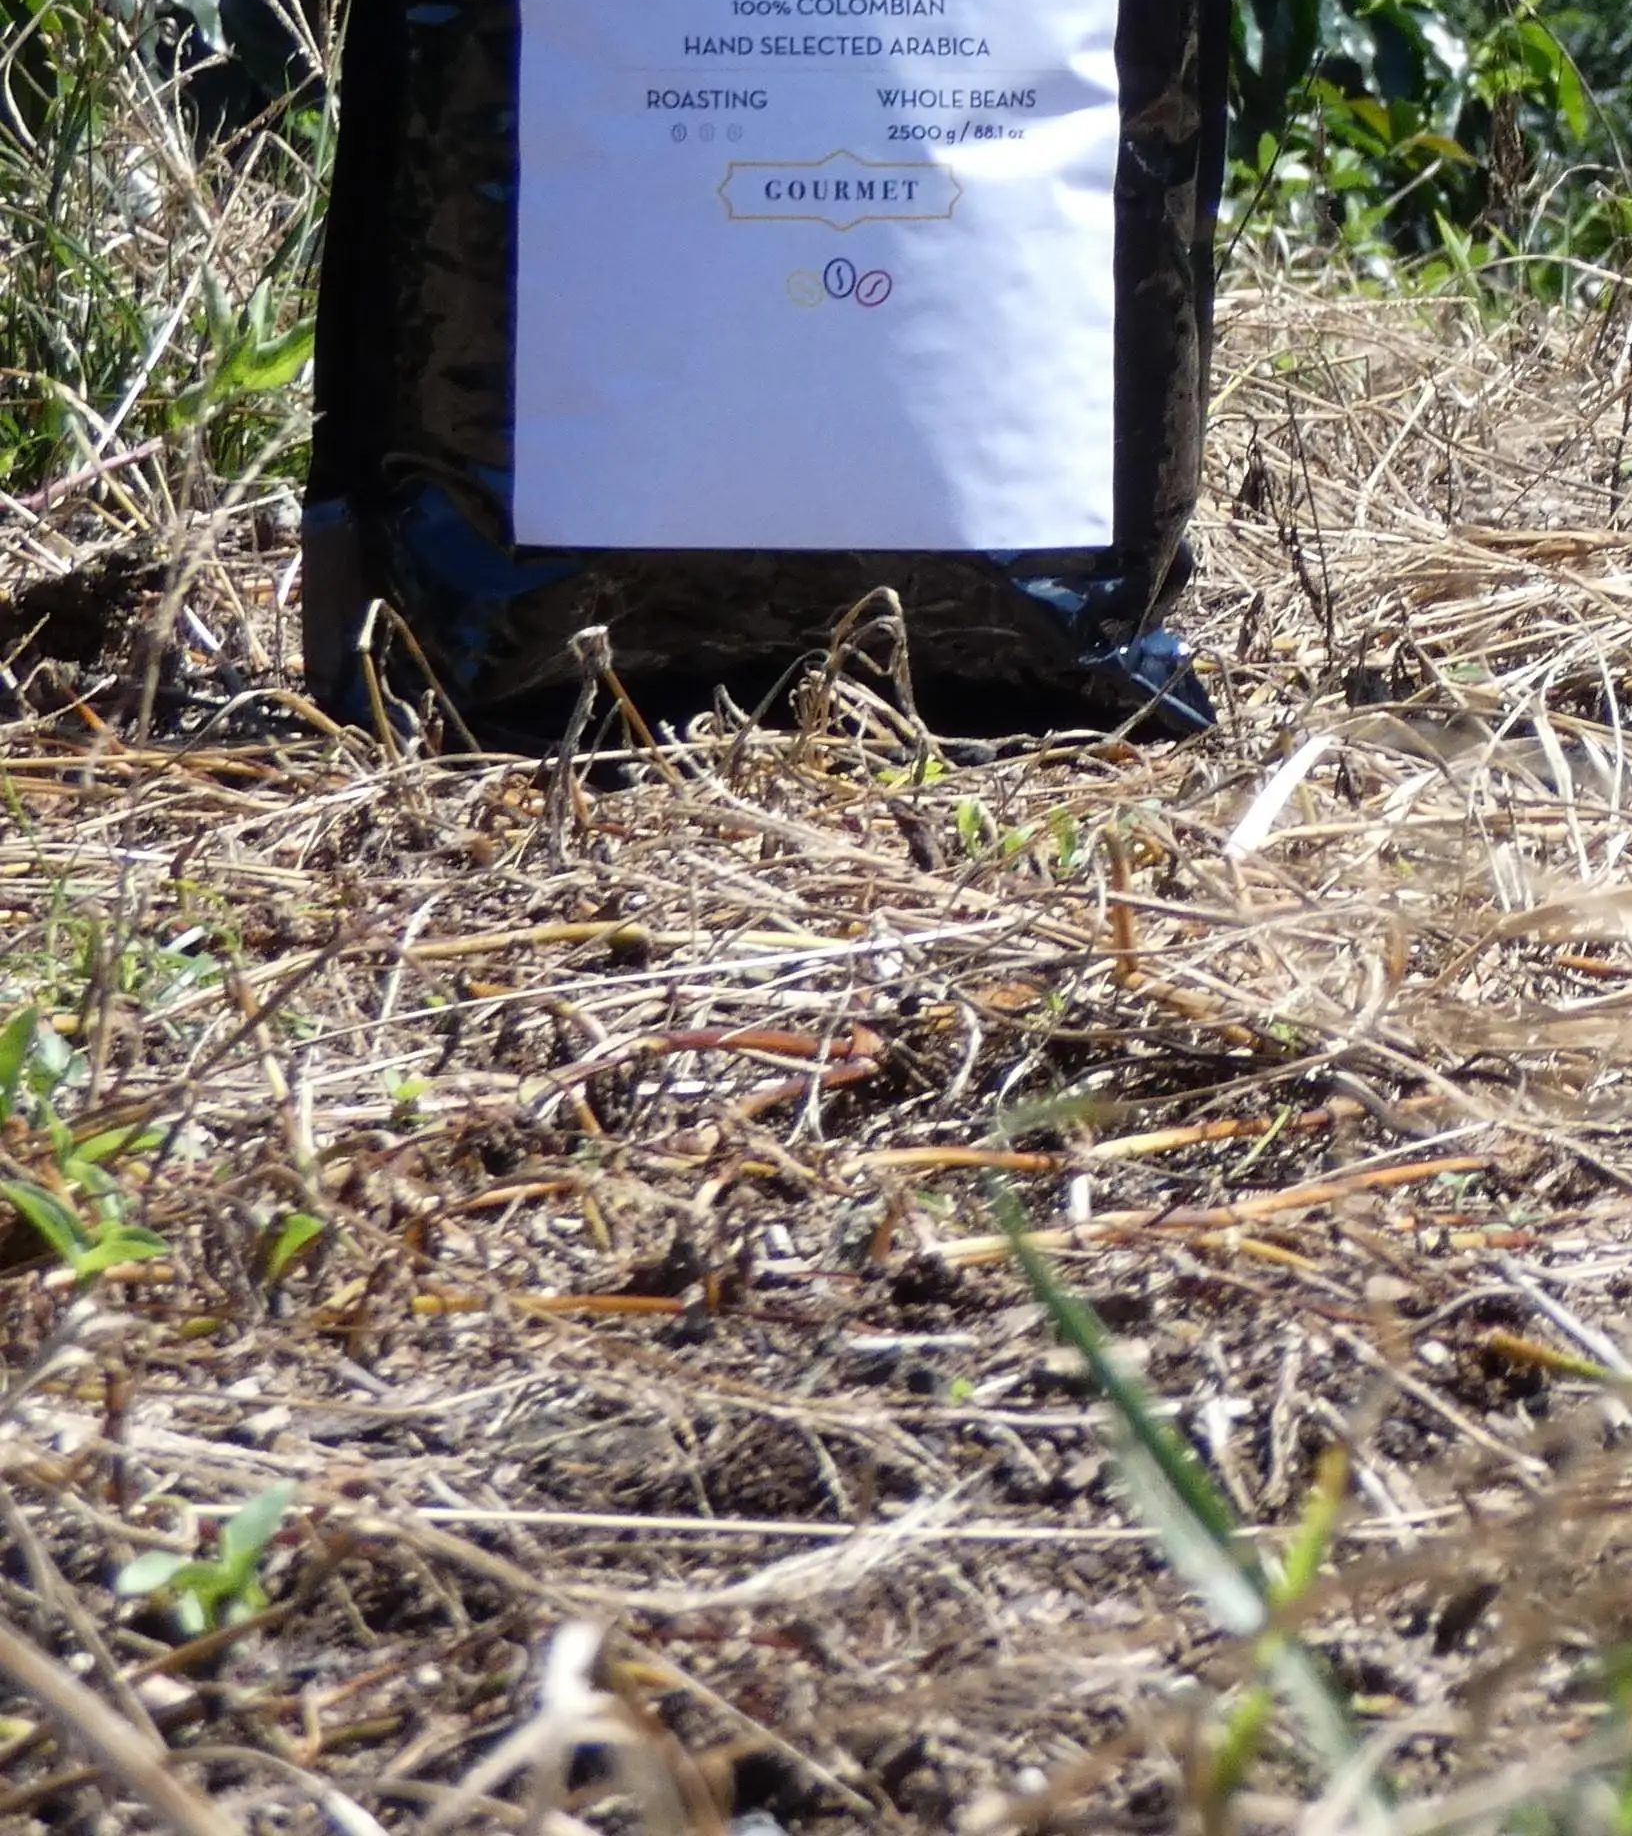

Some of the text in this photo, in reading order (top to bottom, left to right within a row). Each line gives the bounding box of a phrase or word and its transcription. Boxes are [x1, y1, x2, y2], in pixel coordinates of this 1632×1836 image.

[732, 0, 792, 16] 100%
[684, 36, 991, 57] HAND SELECTED ARABICA
[647, 89, 768, 109] ROASTING
[877, 88, 1036, 109] WHOLE BEANS
[888, 124, 941, 141] 2500
[946, 128, 956, 144] g
[973, 123, 1004, 140] 88.1
[764, 179, 919, 202] GOURMET
